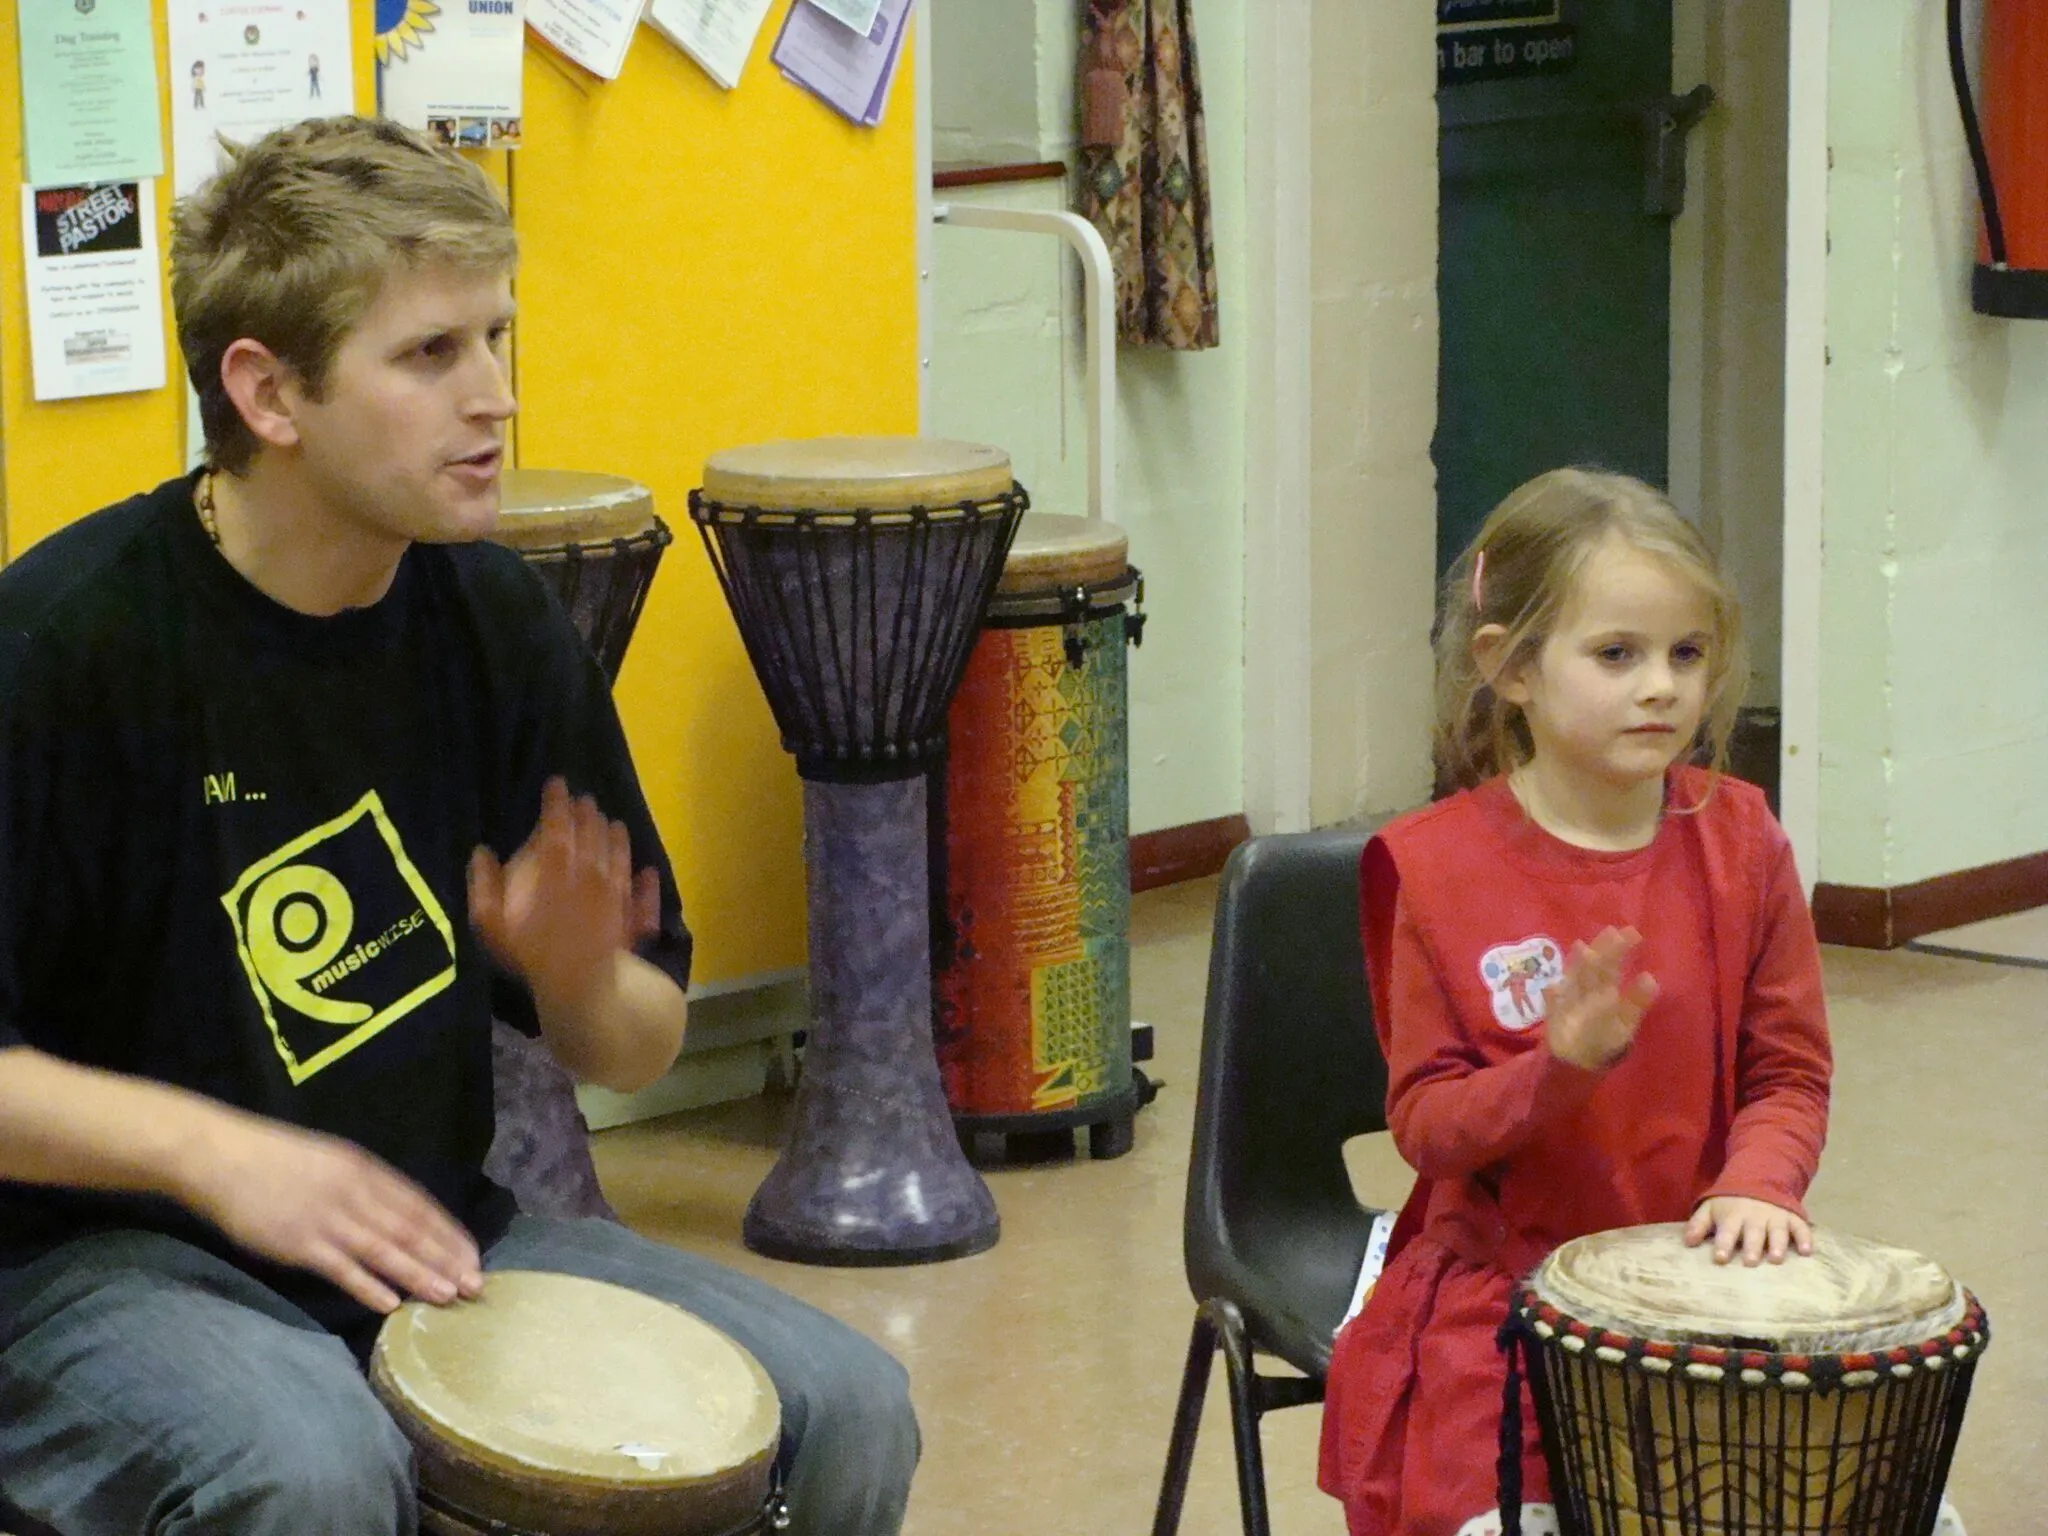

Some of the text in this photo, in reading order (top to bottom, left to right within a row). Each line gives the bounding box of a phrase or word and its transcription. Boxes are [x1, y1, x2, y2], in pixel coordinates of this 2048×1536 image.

[468, 0, 514, 14] UNION
[1453, 41, 1487, 68] bar
[1494, 38, 1515, 65] to
[1523, 37, 1573, 65] open
[56, 184, 123, 235] STREET
[58, 196, 134, 255] PASTOR
